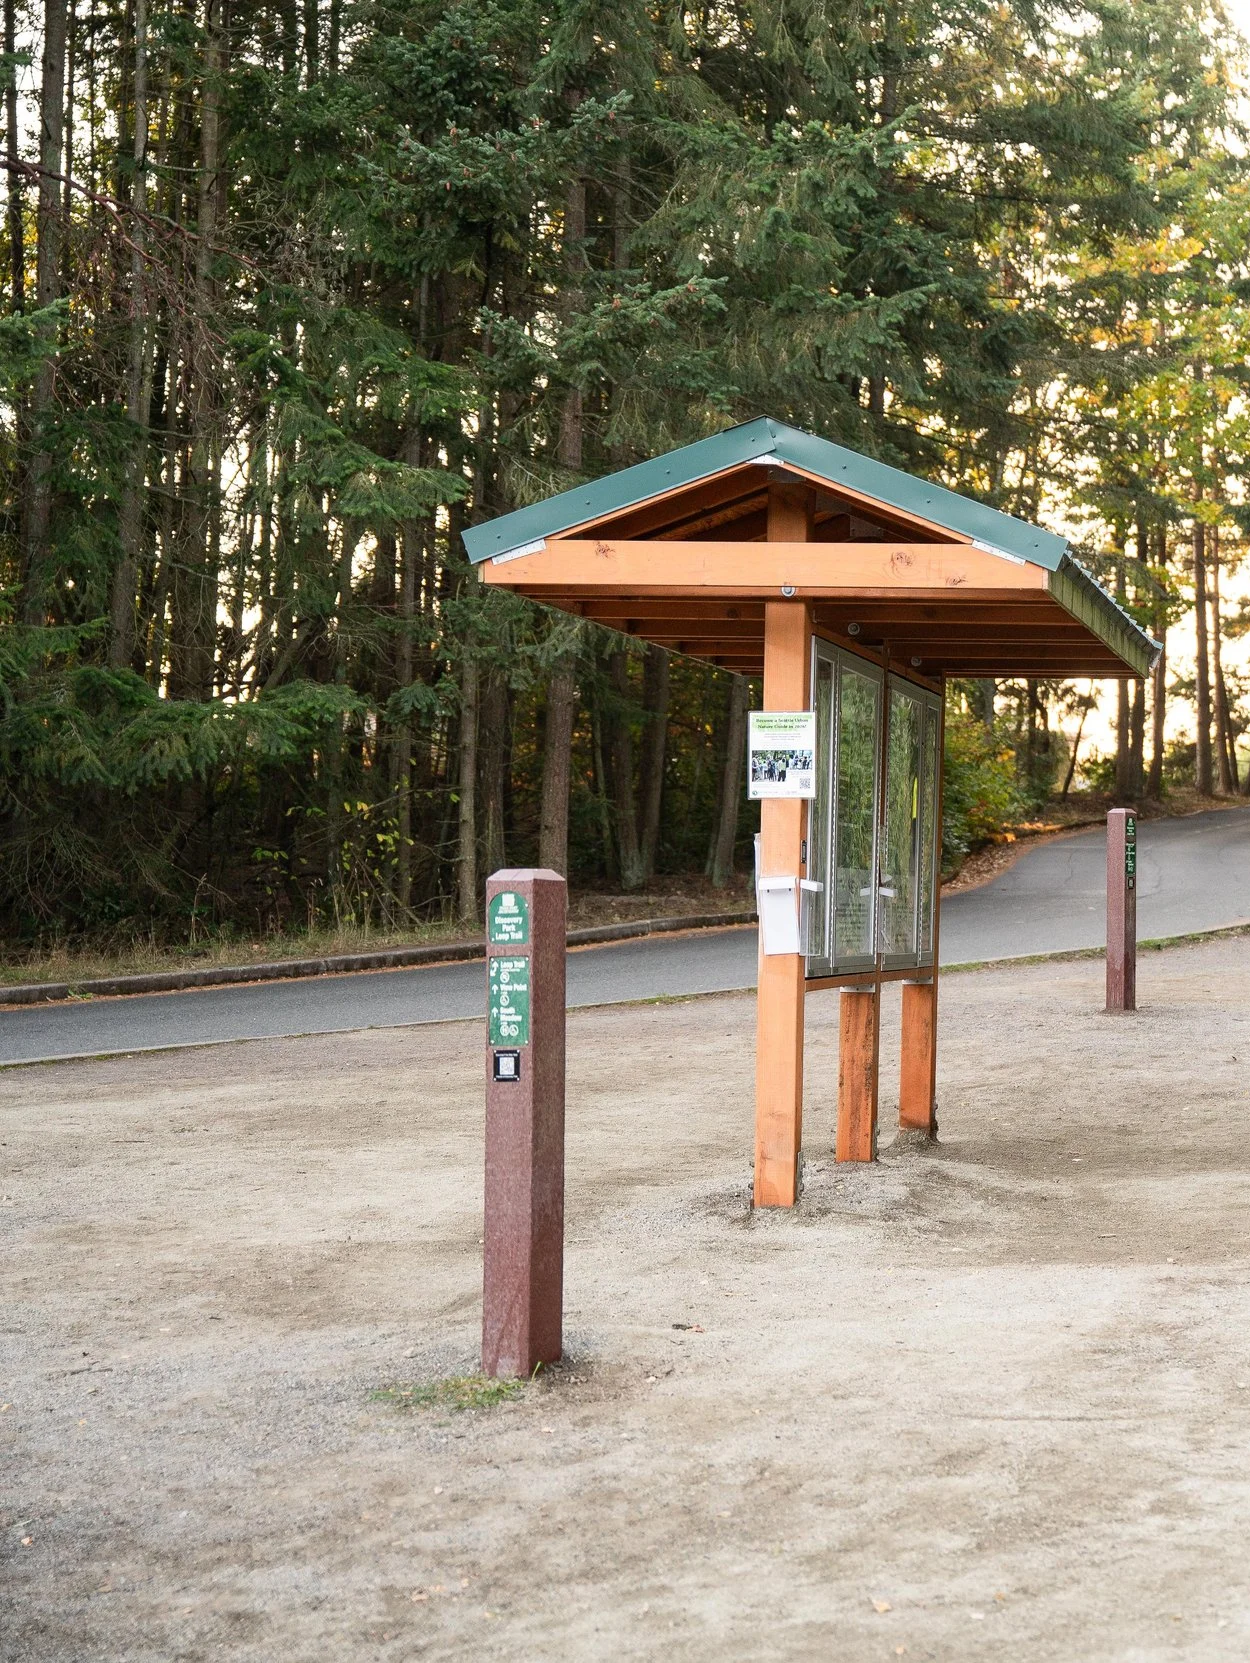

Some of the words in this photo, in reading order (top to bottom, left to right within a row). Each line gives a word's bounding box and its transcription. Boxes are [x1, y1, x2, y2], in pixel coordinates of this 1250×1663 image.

[495, 917, 523, 925] Discovery
[502, 924, 516, 932] Park
[495, 932, 509, 941] Loop
[510, 931, 523, 939] Trail
[500, 961, 513, 969] Loop
[514, 960, 525, 968] Trail
[513, 983, 528, 991] Point
